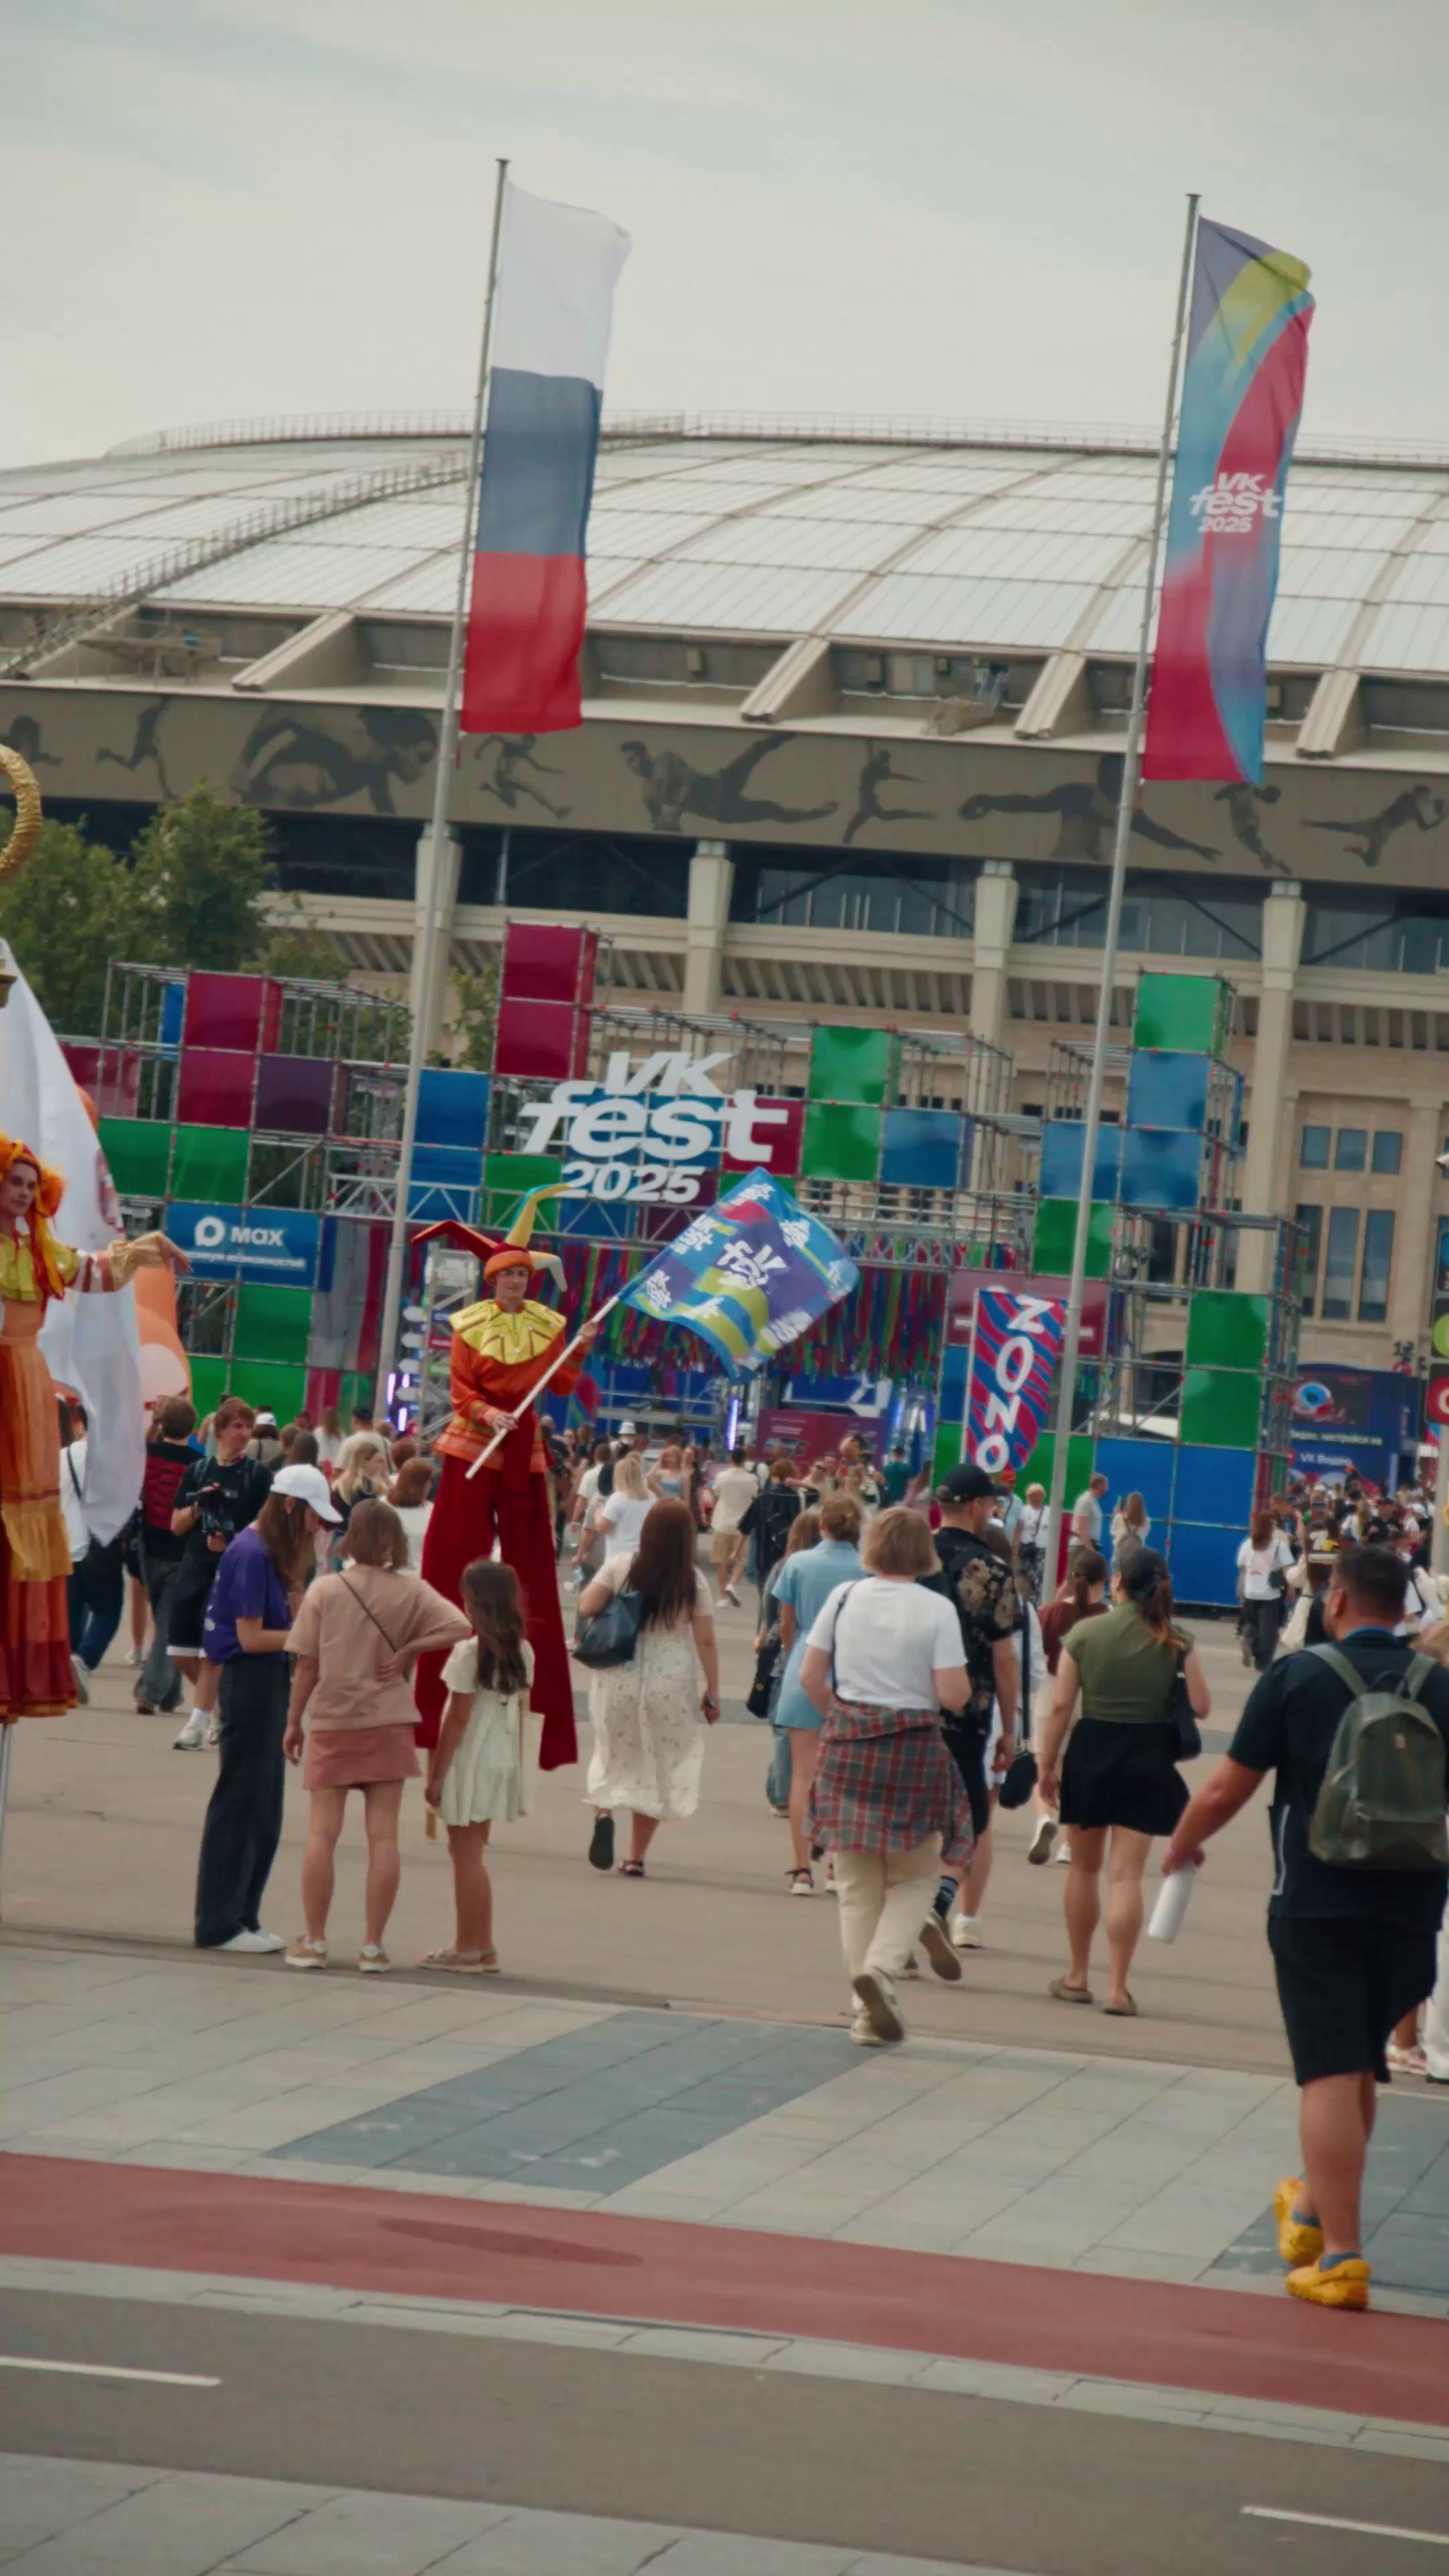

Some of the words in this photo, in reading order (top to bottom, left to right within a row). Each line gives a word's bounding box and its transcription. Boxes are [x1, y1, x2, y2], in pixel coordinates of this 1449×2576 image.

[1189, 484, 1283, 518] fest
[1218, 472, 1267, 492] VK
[1197, 516, 1252, 532] 2025
[604, 1051, 737, 1097] VK
[519, 1080, 789, 1163] fest
[553, 1161, 706, 1203] 2025
